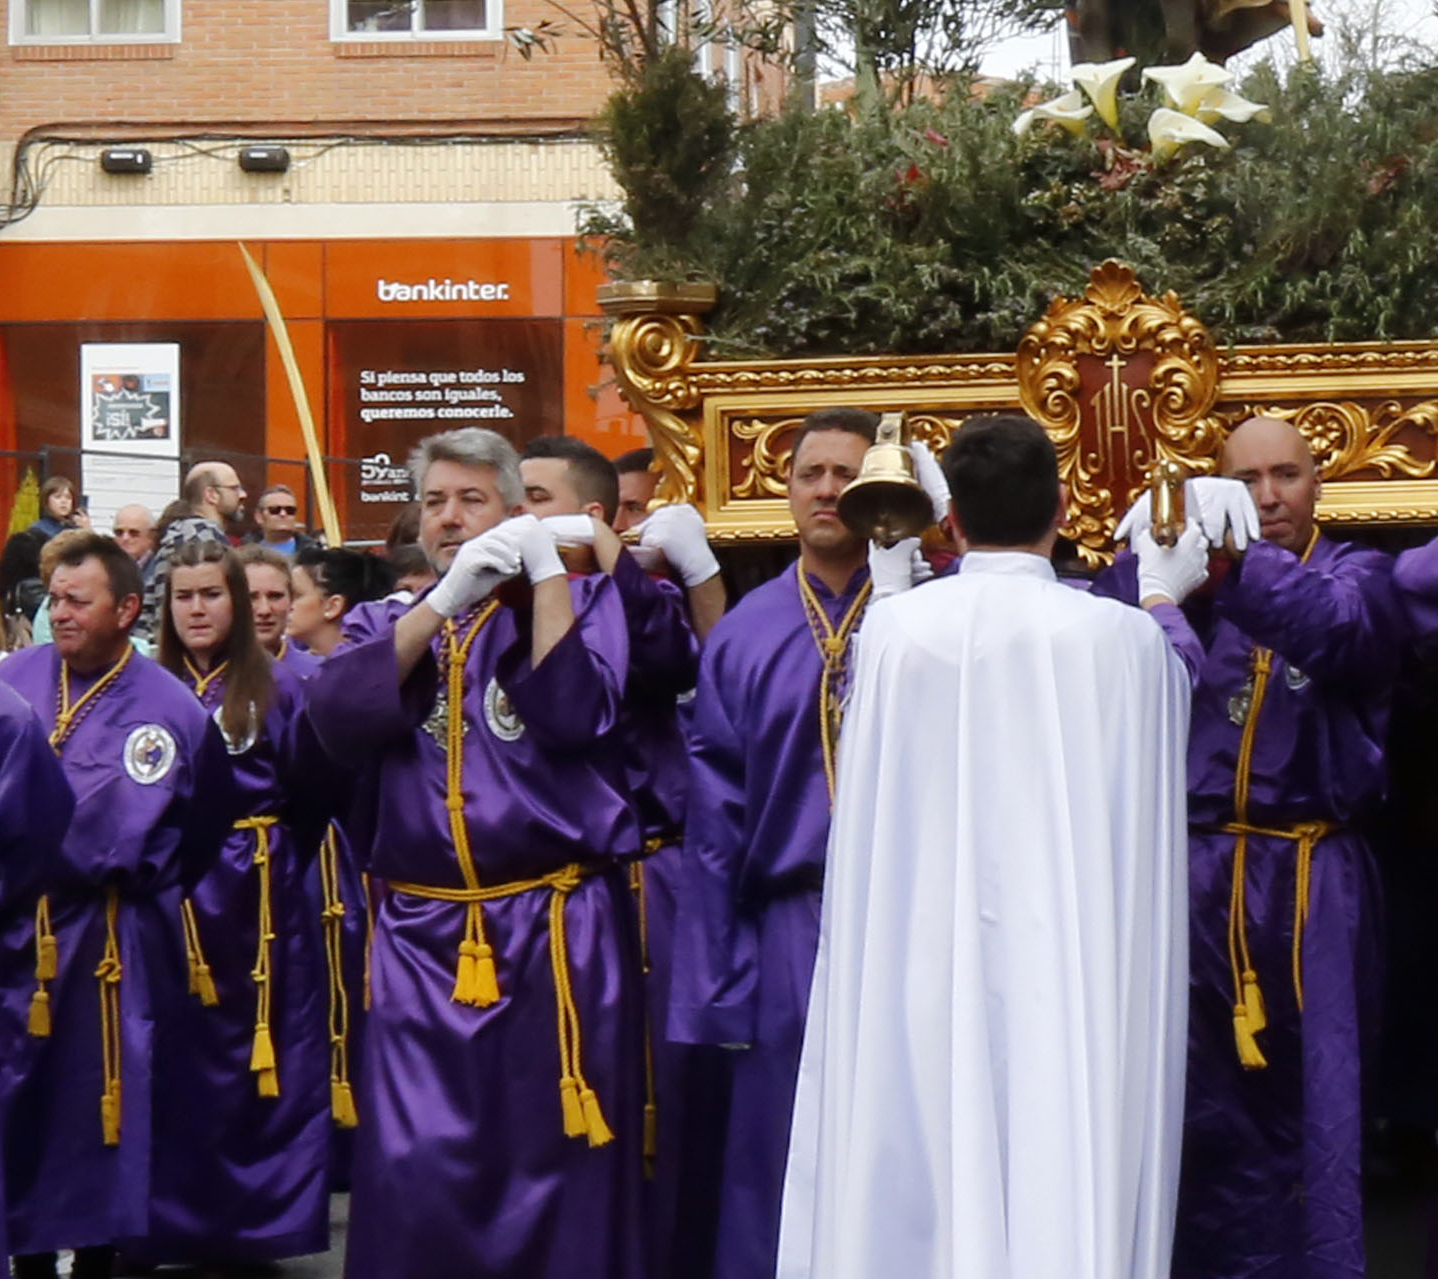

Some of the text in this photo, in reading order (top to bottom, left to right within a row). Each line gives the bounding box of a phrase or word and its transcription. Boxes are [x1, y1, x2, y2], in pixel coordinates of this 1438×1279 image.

[377, 279, 510, 302] bankinter.
[377, 371, 427, 387] piensa
[429, 373, 457, 387] que
[459, 369, 500, 384] todos
[502, 369, 525, 383] los
[360, 387, 502, 404] bancos son iguales,
[360, 405, 514, 422] queremos conocerle.
